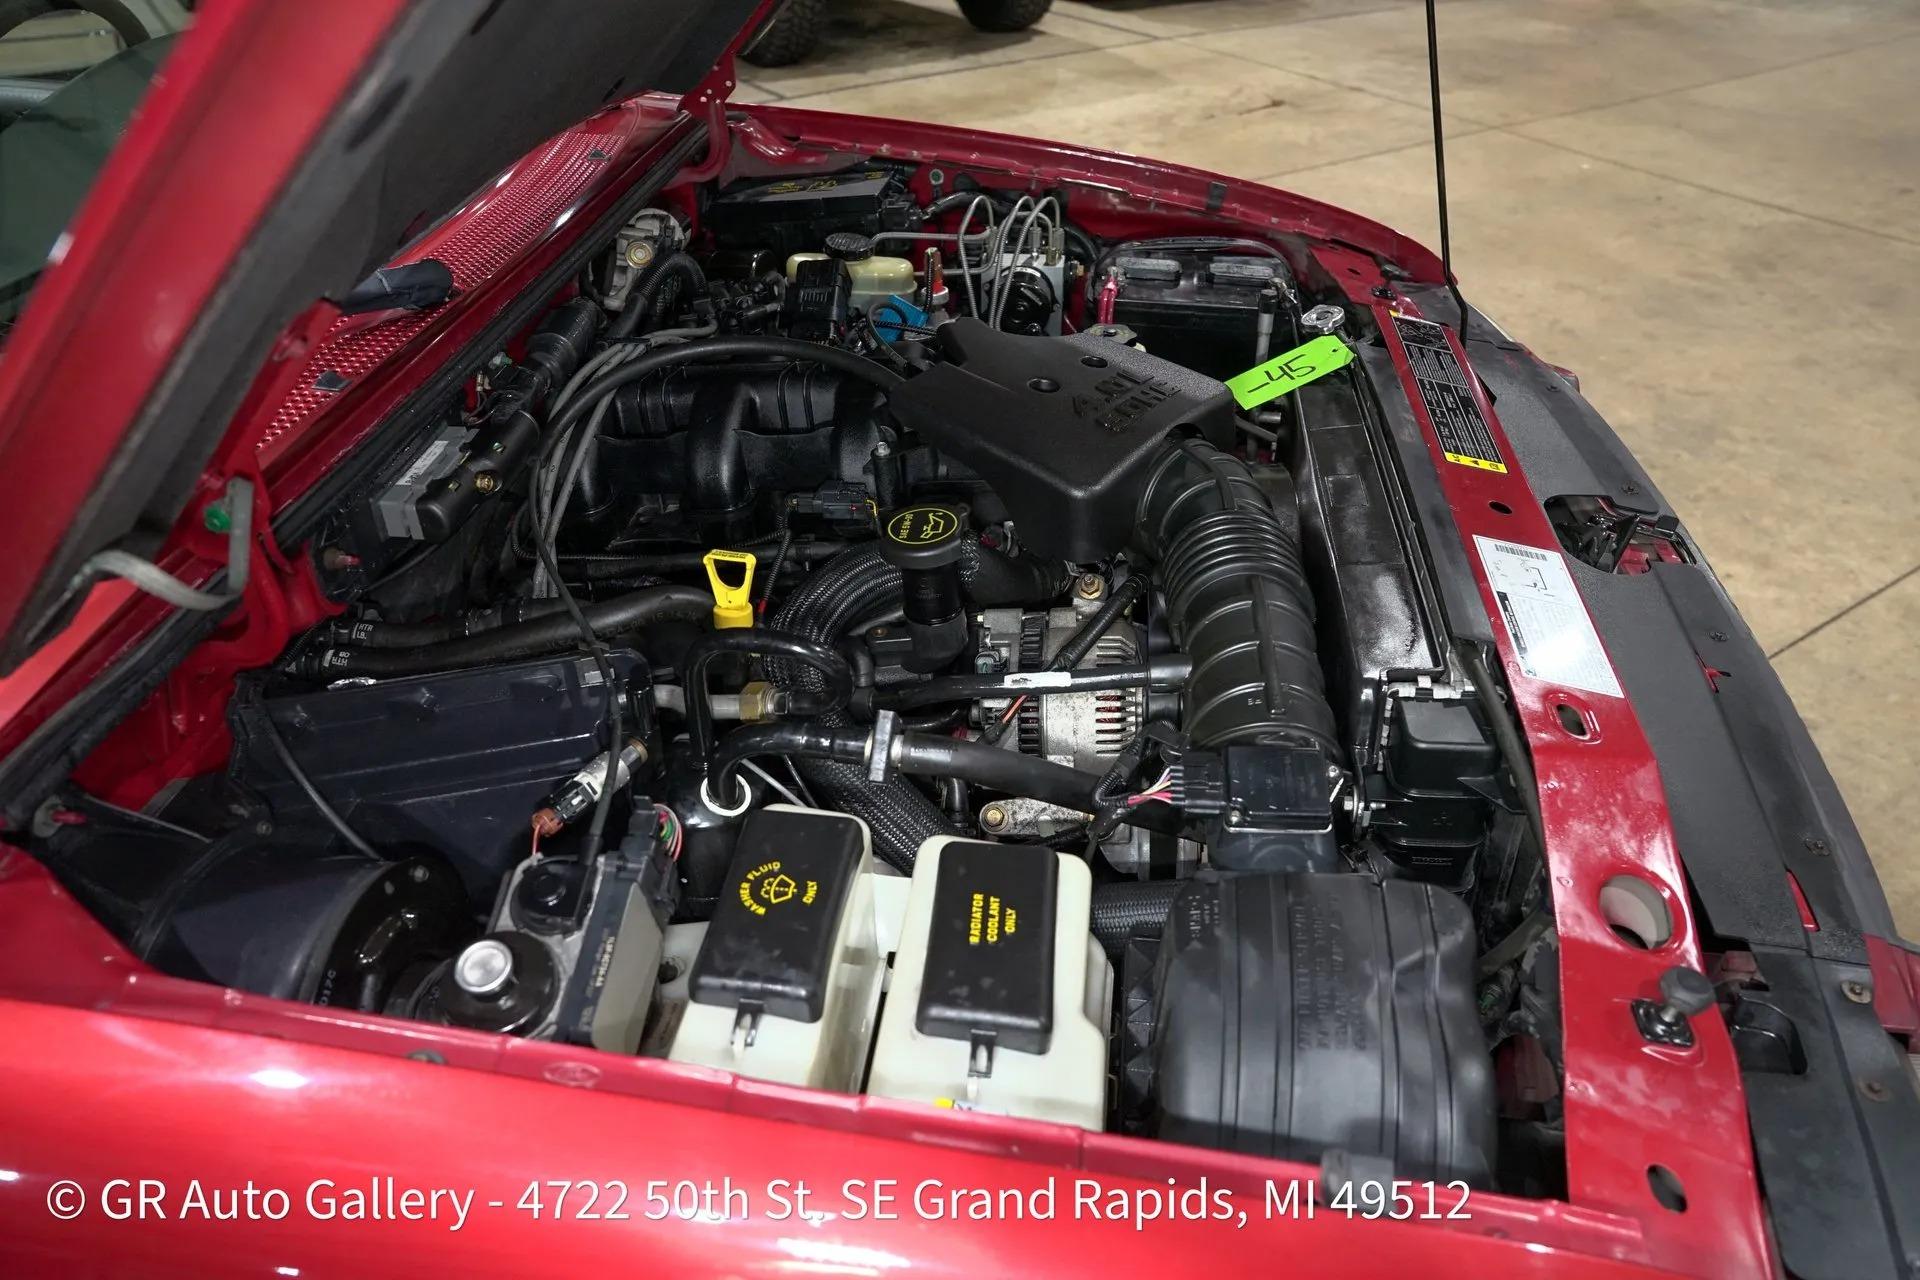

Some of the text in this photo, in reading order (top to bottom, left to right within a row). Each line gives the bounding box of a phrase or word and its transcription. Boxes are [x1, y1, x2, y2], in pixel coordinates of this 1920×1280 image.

[1247, 353, 1317, 394] -45
[739, 861, 818, 916] WASHER FLUID ONLY
[969, 893, 985, 946] RADIATOR
[986, 895, 1001, 944] COOLANT
[1004, 907, 1017, 935] ONLY
